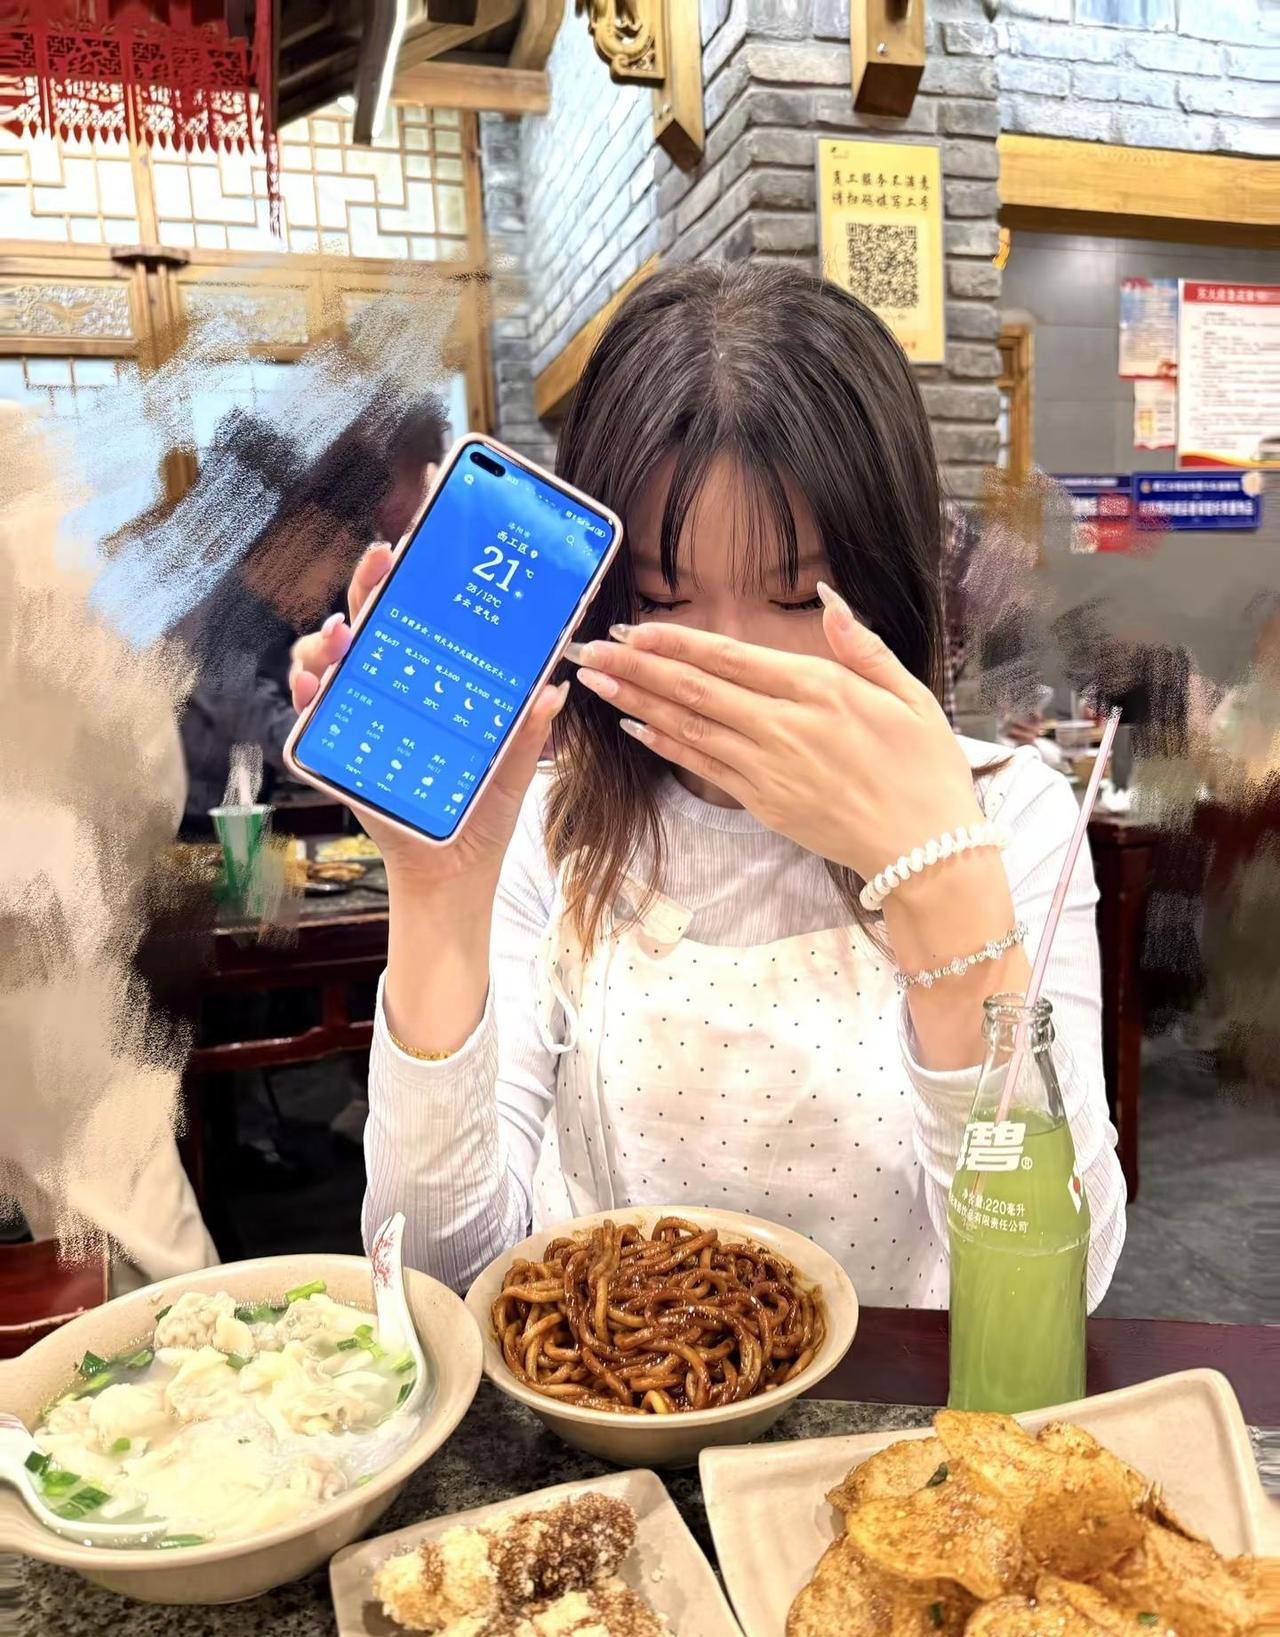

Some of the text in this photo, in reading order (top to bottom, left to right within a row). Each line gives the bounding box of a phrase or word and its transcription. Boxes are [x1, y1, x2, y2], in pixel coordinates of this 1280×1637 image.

[496, 530, 530, 556] 西工区
[471, 545, 521, 593] 21
